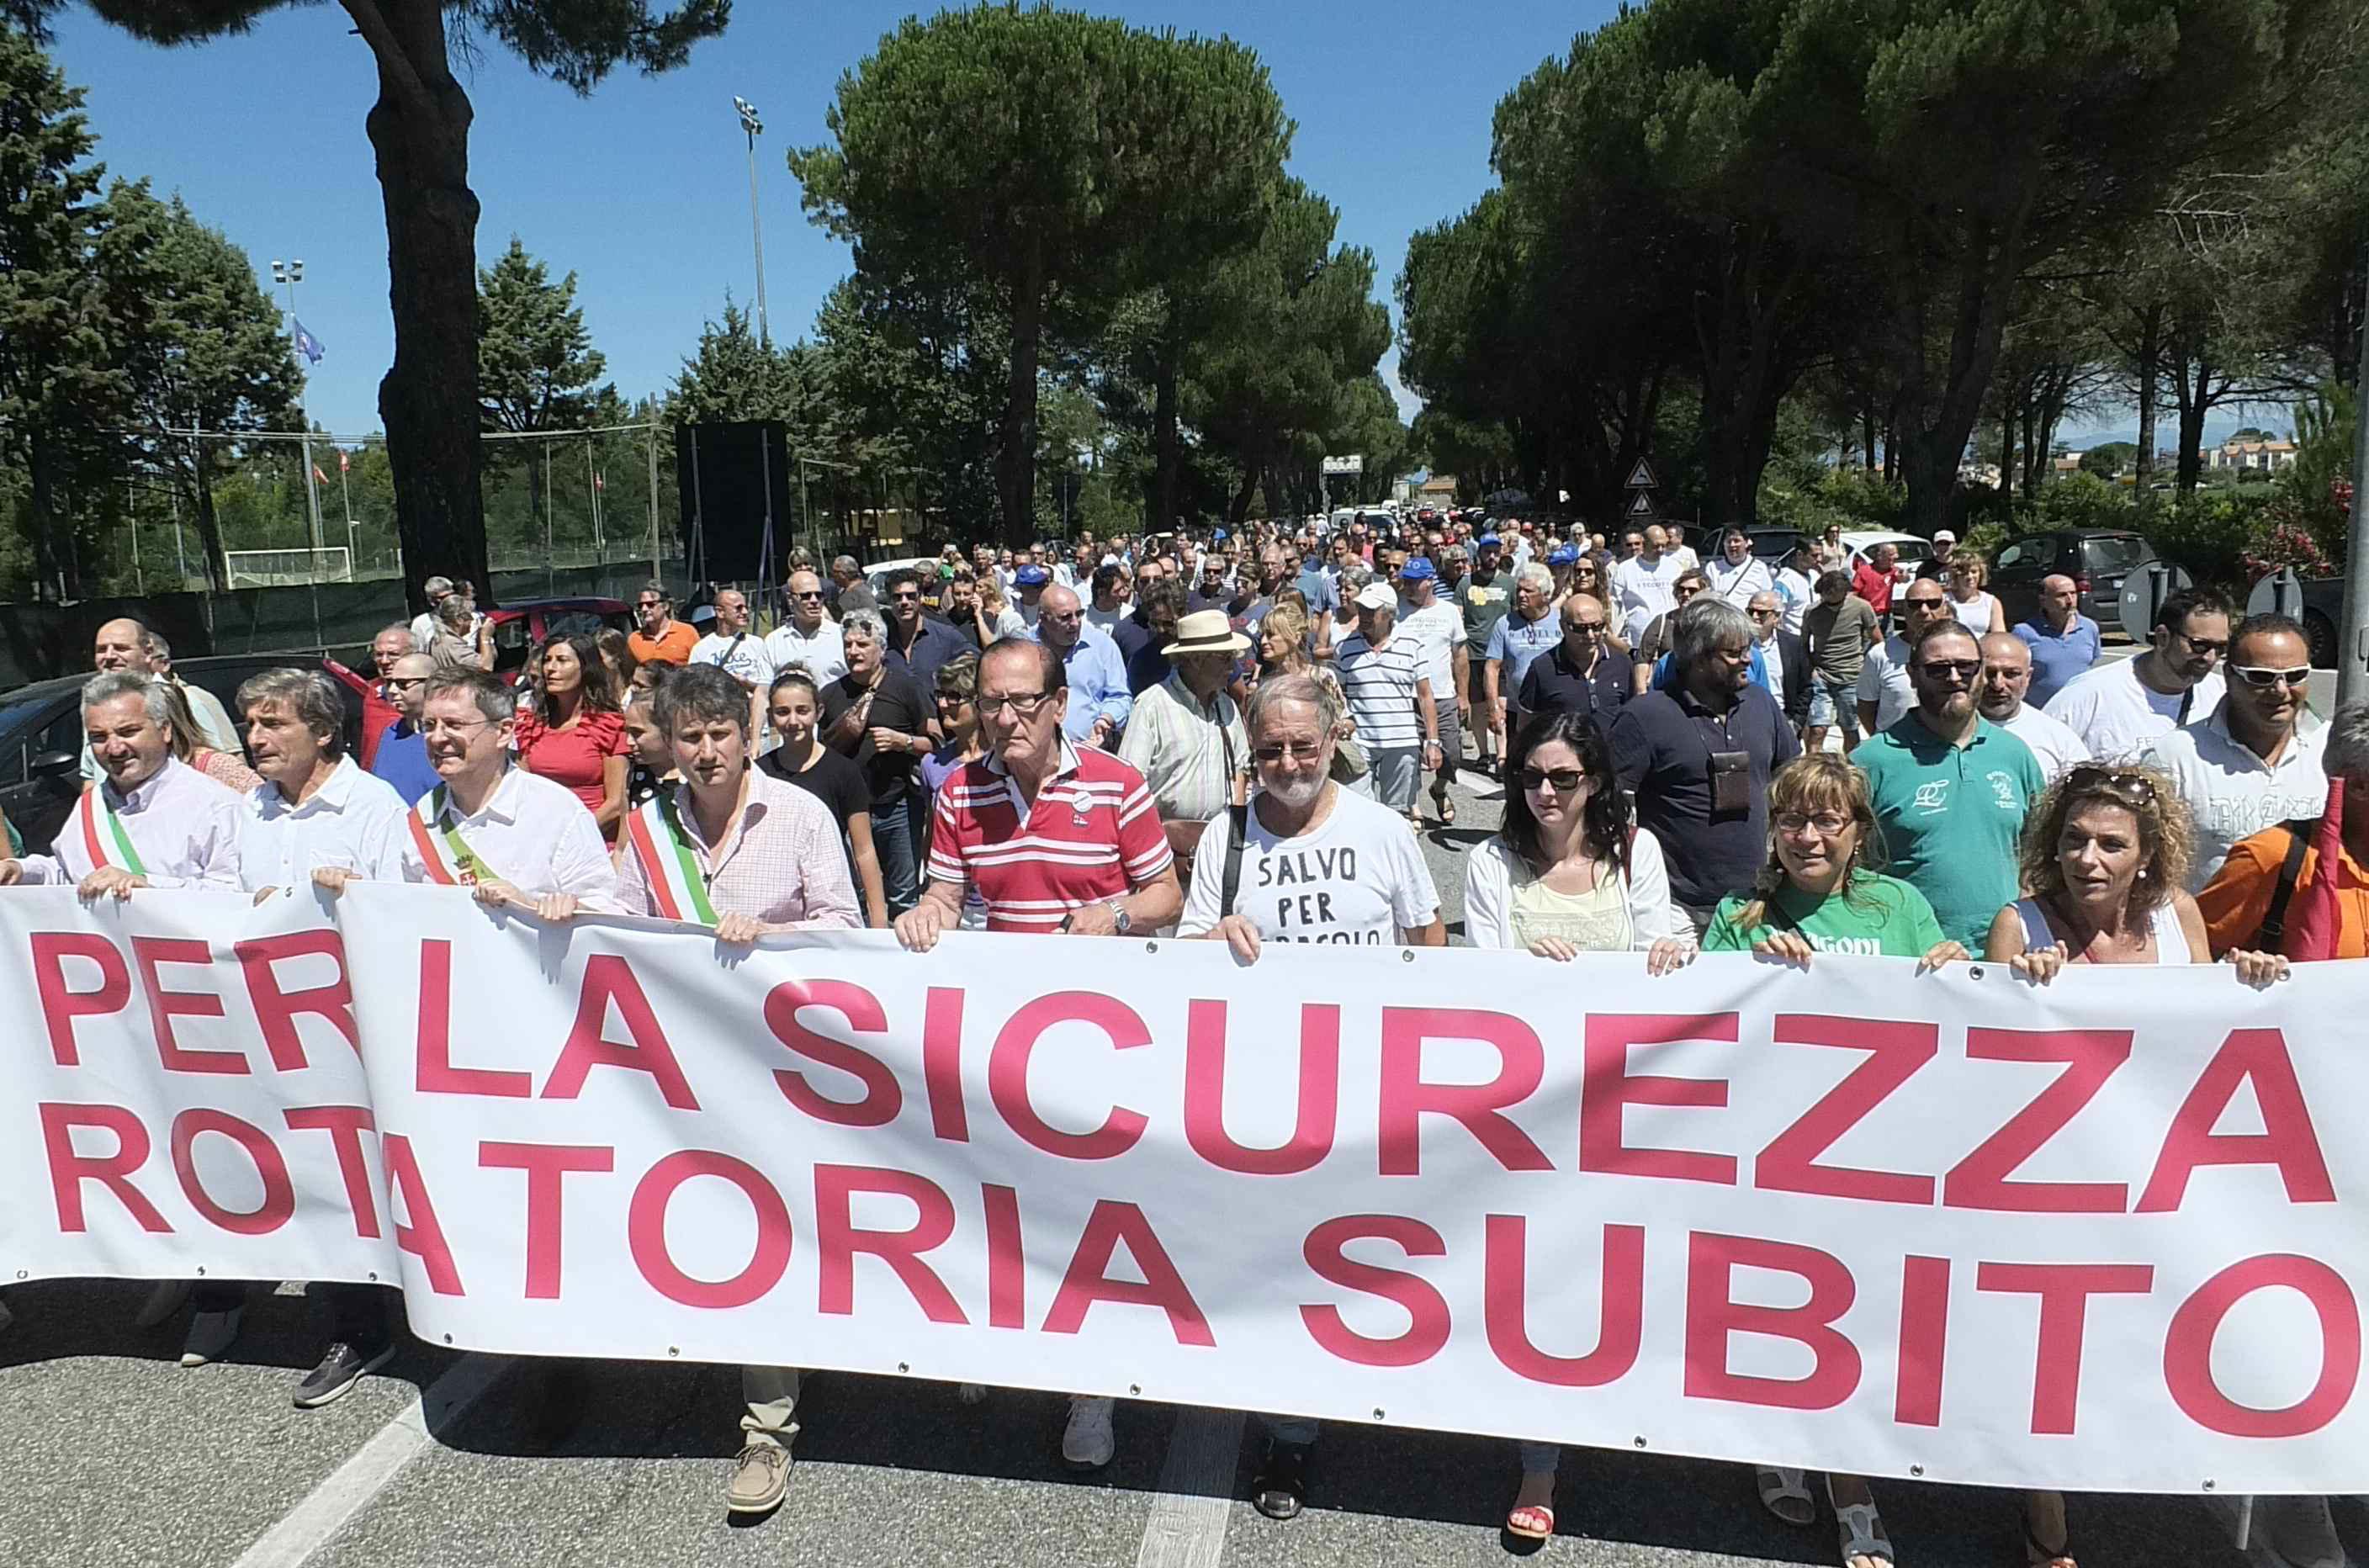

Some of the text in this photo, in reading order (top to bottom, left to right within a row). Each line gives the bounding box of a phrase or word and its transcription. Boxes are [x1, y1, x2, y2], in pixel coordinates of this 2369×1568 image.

[1258, 847, 1356, 887] SALVO
[1278, 892, 1336, 928] PER
[30, 928, 2338, 1214] PER LA SICUREZZA
[38, 1102, 2361, 1438] ROTATORIA SUBITO
